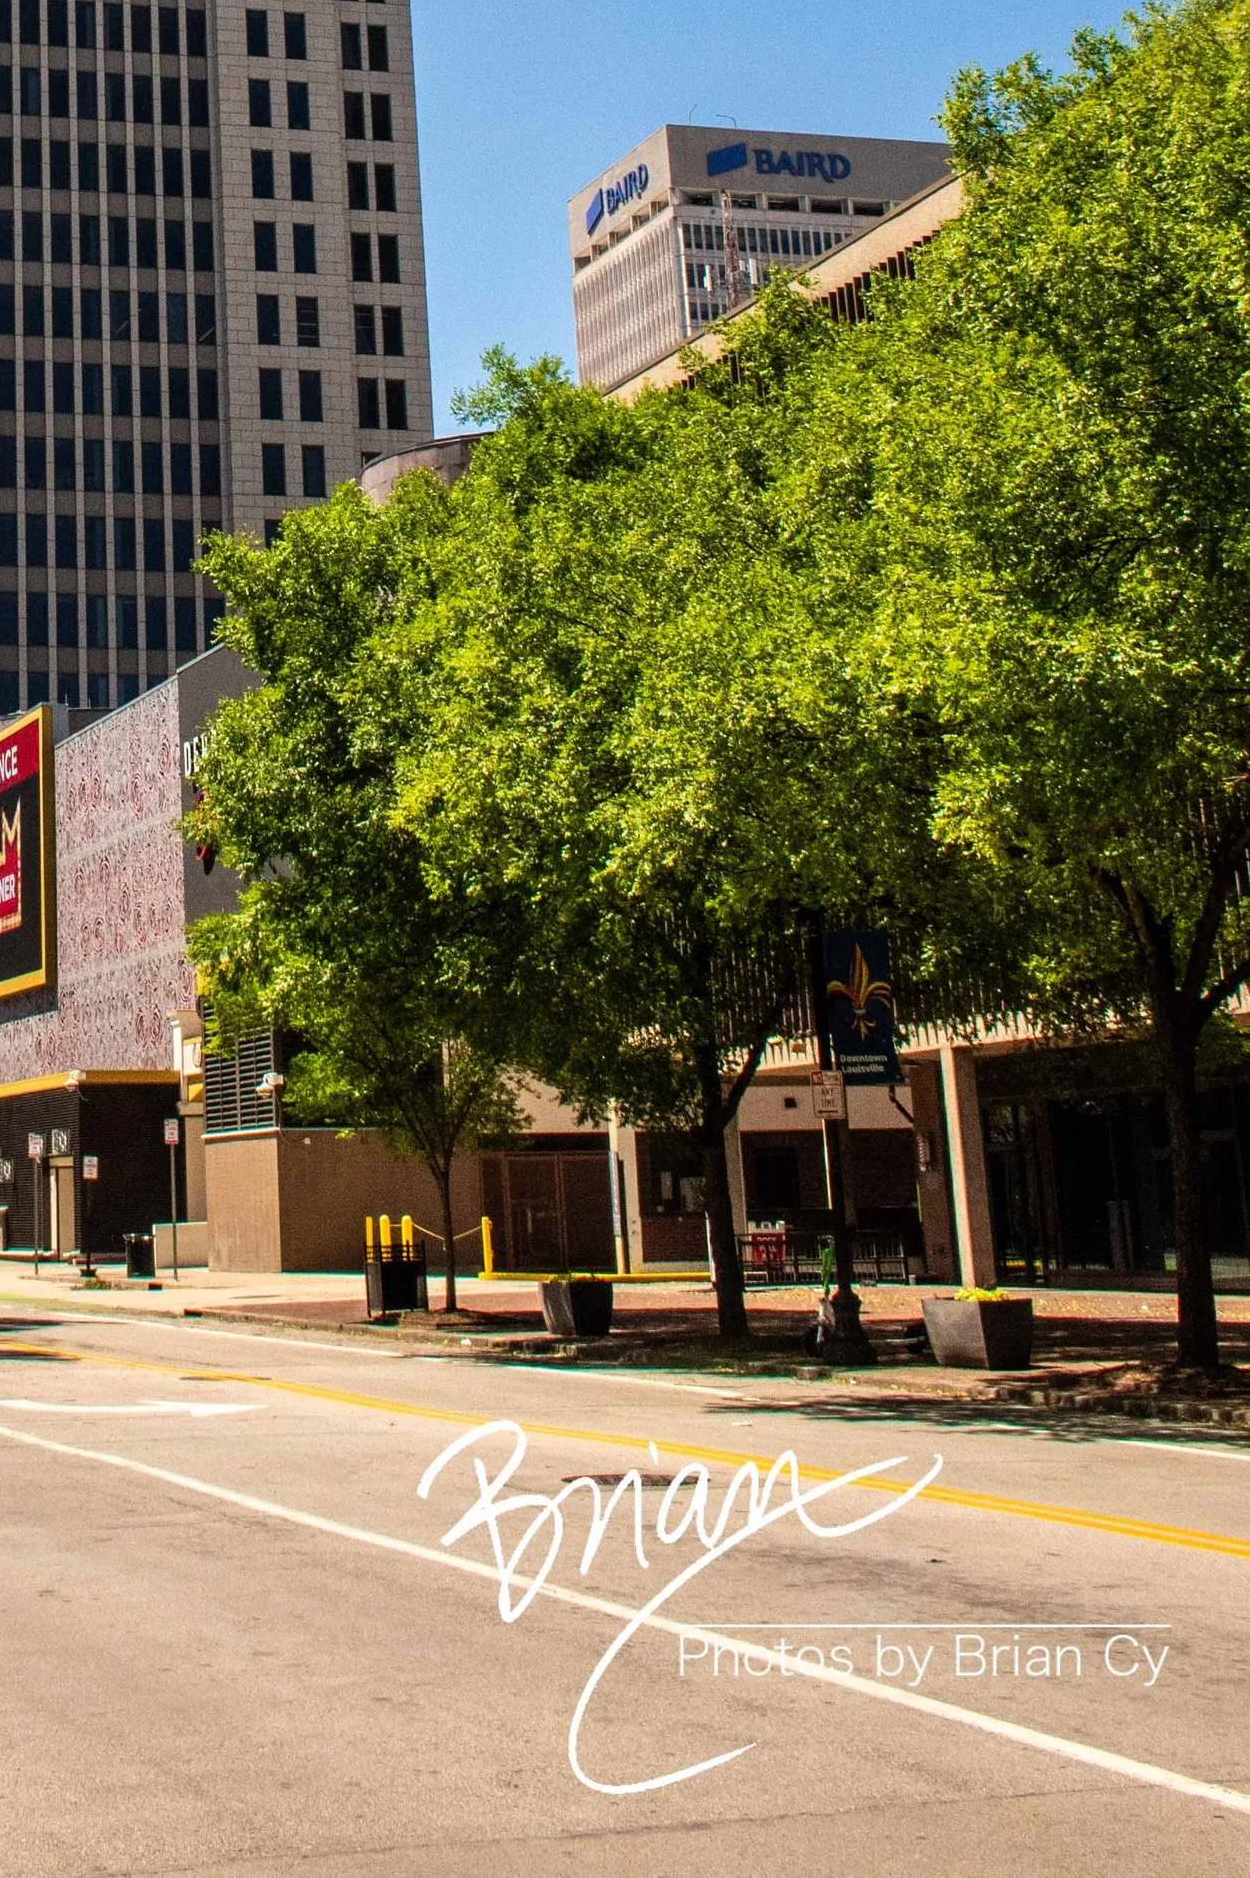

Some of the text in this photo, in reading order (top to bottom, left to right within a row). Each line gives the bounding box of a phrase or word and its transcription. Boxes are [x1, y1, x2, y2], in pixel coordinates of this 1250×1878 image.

[753, 149, 850, 183] BAIRD
[606, 163, 649, 215] BAIRD
[840, 1054, 887, 1063] Downtown
[841, 1064, 884, 1073] Louisville
[821, 1088, 833, 1097] ANY
